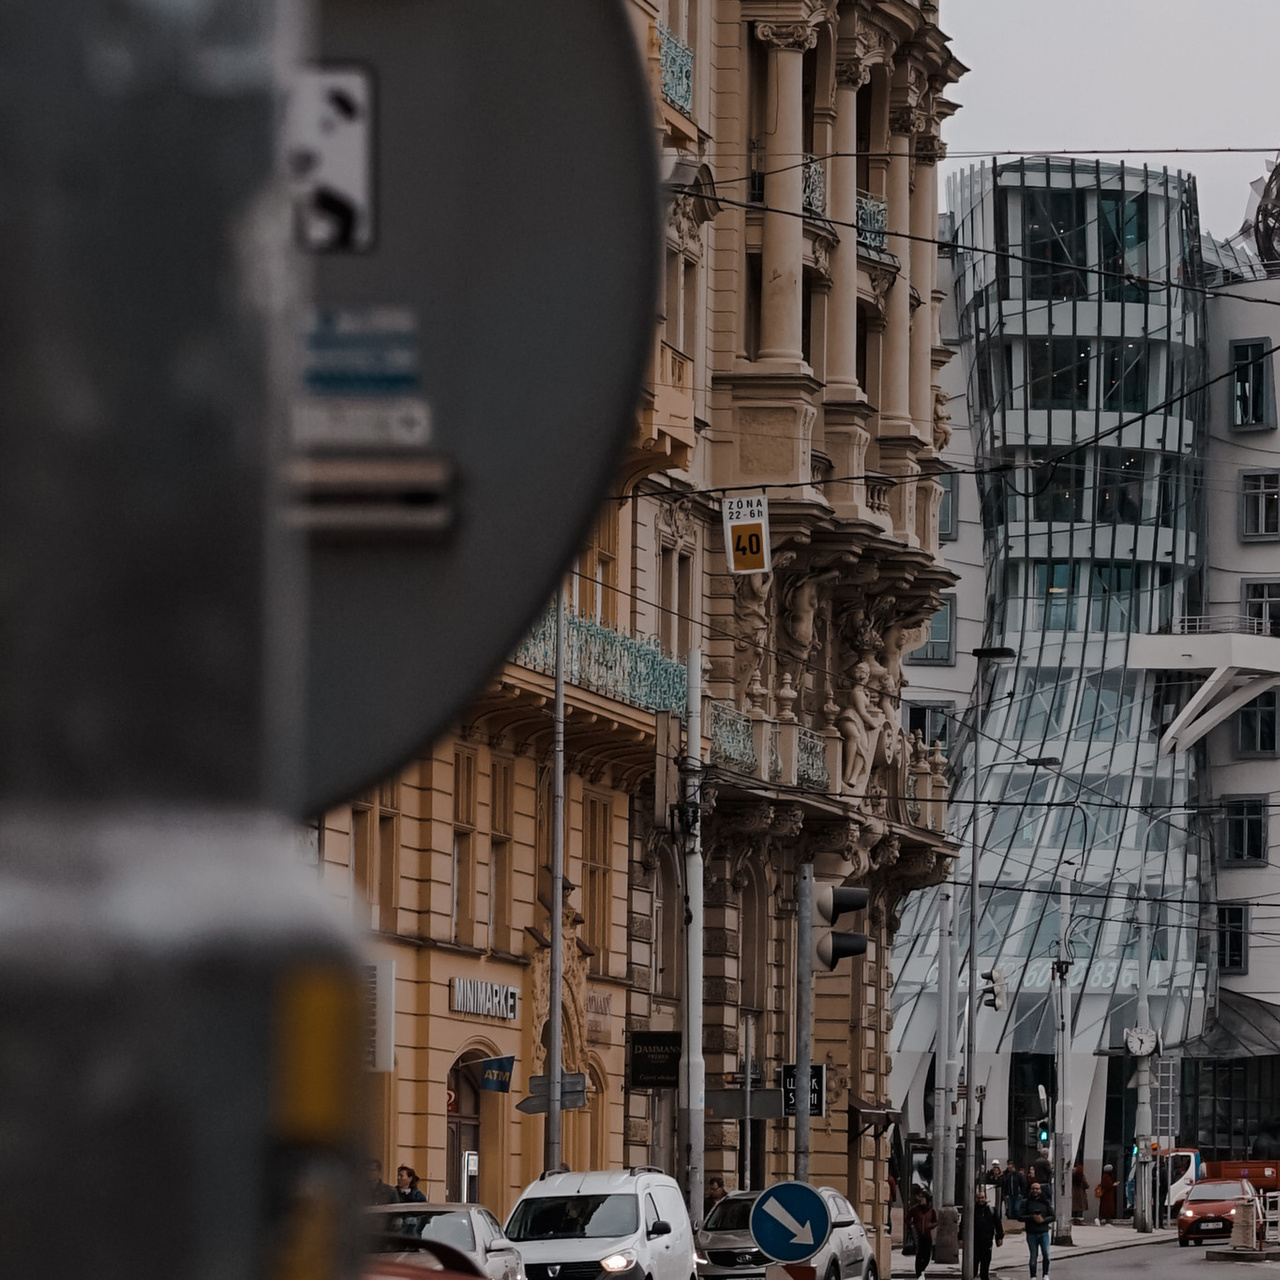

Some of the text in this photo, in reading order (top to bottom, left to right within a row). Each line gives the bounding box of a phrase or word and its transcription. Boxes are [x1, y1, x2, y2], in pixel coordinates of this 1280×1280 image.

[728, 498, 762, 510] ZÓNA
[735, 533, 760, 556] 40
[454, 977, 521, 1019] MINIMARKET
[483, 1069, 510, 1083] ATM
[786, 1077, 819, 1090] WK
